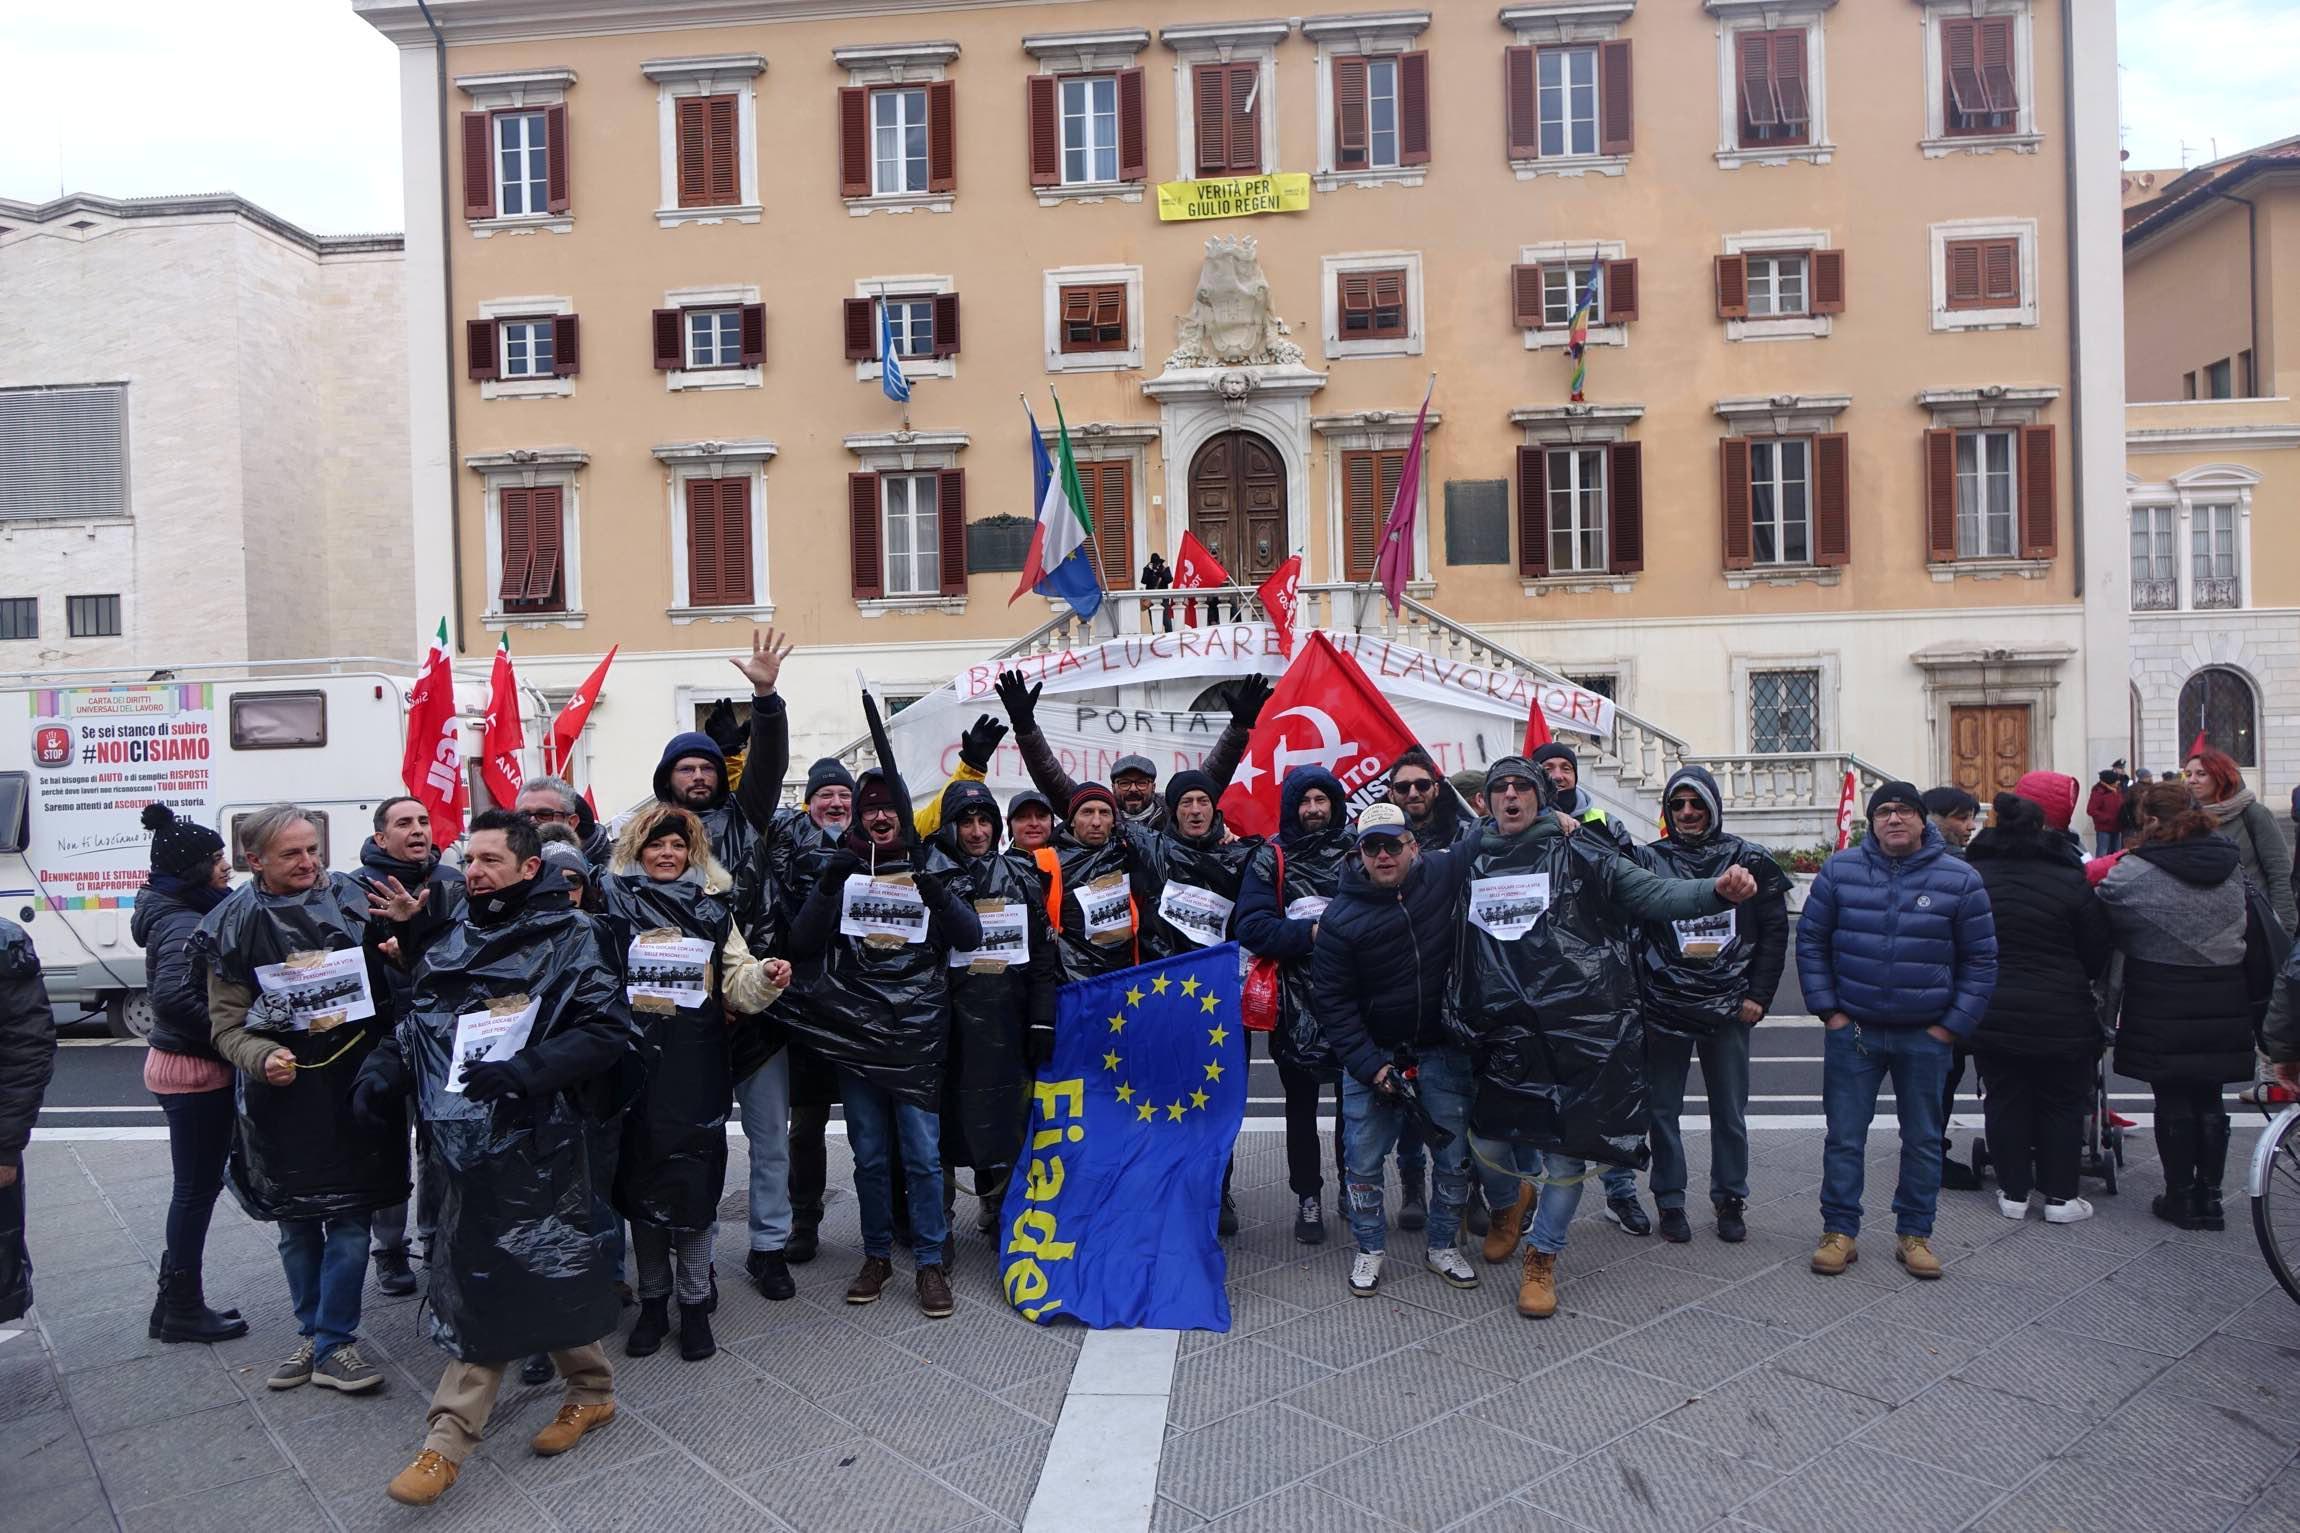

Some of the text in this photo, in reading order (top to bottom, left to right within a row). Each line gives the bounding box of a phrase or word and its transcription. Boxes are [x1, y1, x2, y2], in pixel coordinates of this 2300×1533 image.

[1198, 180, 1270, 200] VERITÀ PER
[1188, 200, 1230, 216] GIULIO
[1236, 196, 1280, 213] REGENI
[1100, 626, 1282, 671] LUCRARE
[1380, 643, 1602, 726] LAVORATORI
[88, 696, 151, 704] CARTA DEI DIRITTI
[76, 705, 119, 713] UNIVERSALI
[1076, 706, 1210, 733] PORTA
[82, 722, 208, 739] Se sei stanco di subire
[44, 749, 63, 760] STOP
[82, 738, 210, 764] #NOICISIAMO
[50, 776, 60, 784] hai
[62, 776, 90, 784] bisogno
[99, 772, 123, 782] AIUTO
[138, 772, 168, 782] semplici
[170, 770, 208, 780] RISPOSTE
[496, 756, 524, 791] ANA
[157, 782, 176, 791] TUOI
[178, 781, 208, 790] DIRITTI
[44, 803, 74, 812] Saremo
[76, 802, 102, 810] attenti
[103, 801, 113, 810] ad
[174, 815, 194, 824] GIL
[57, 838, 78, 851] Non
[82, 835, 90, 848] ti
[95, 832, 139, 847] lasciamo
[40, 869, 150, 883] DENUNCIANDO LE SITUAZIO
[77, 880, 148, 891] CI RIAPPROPRIE
